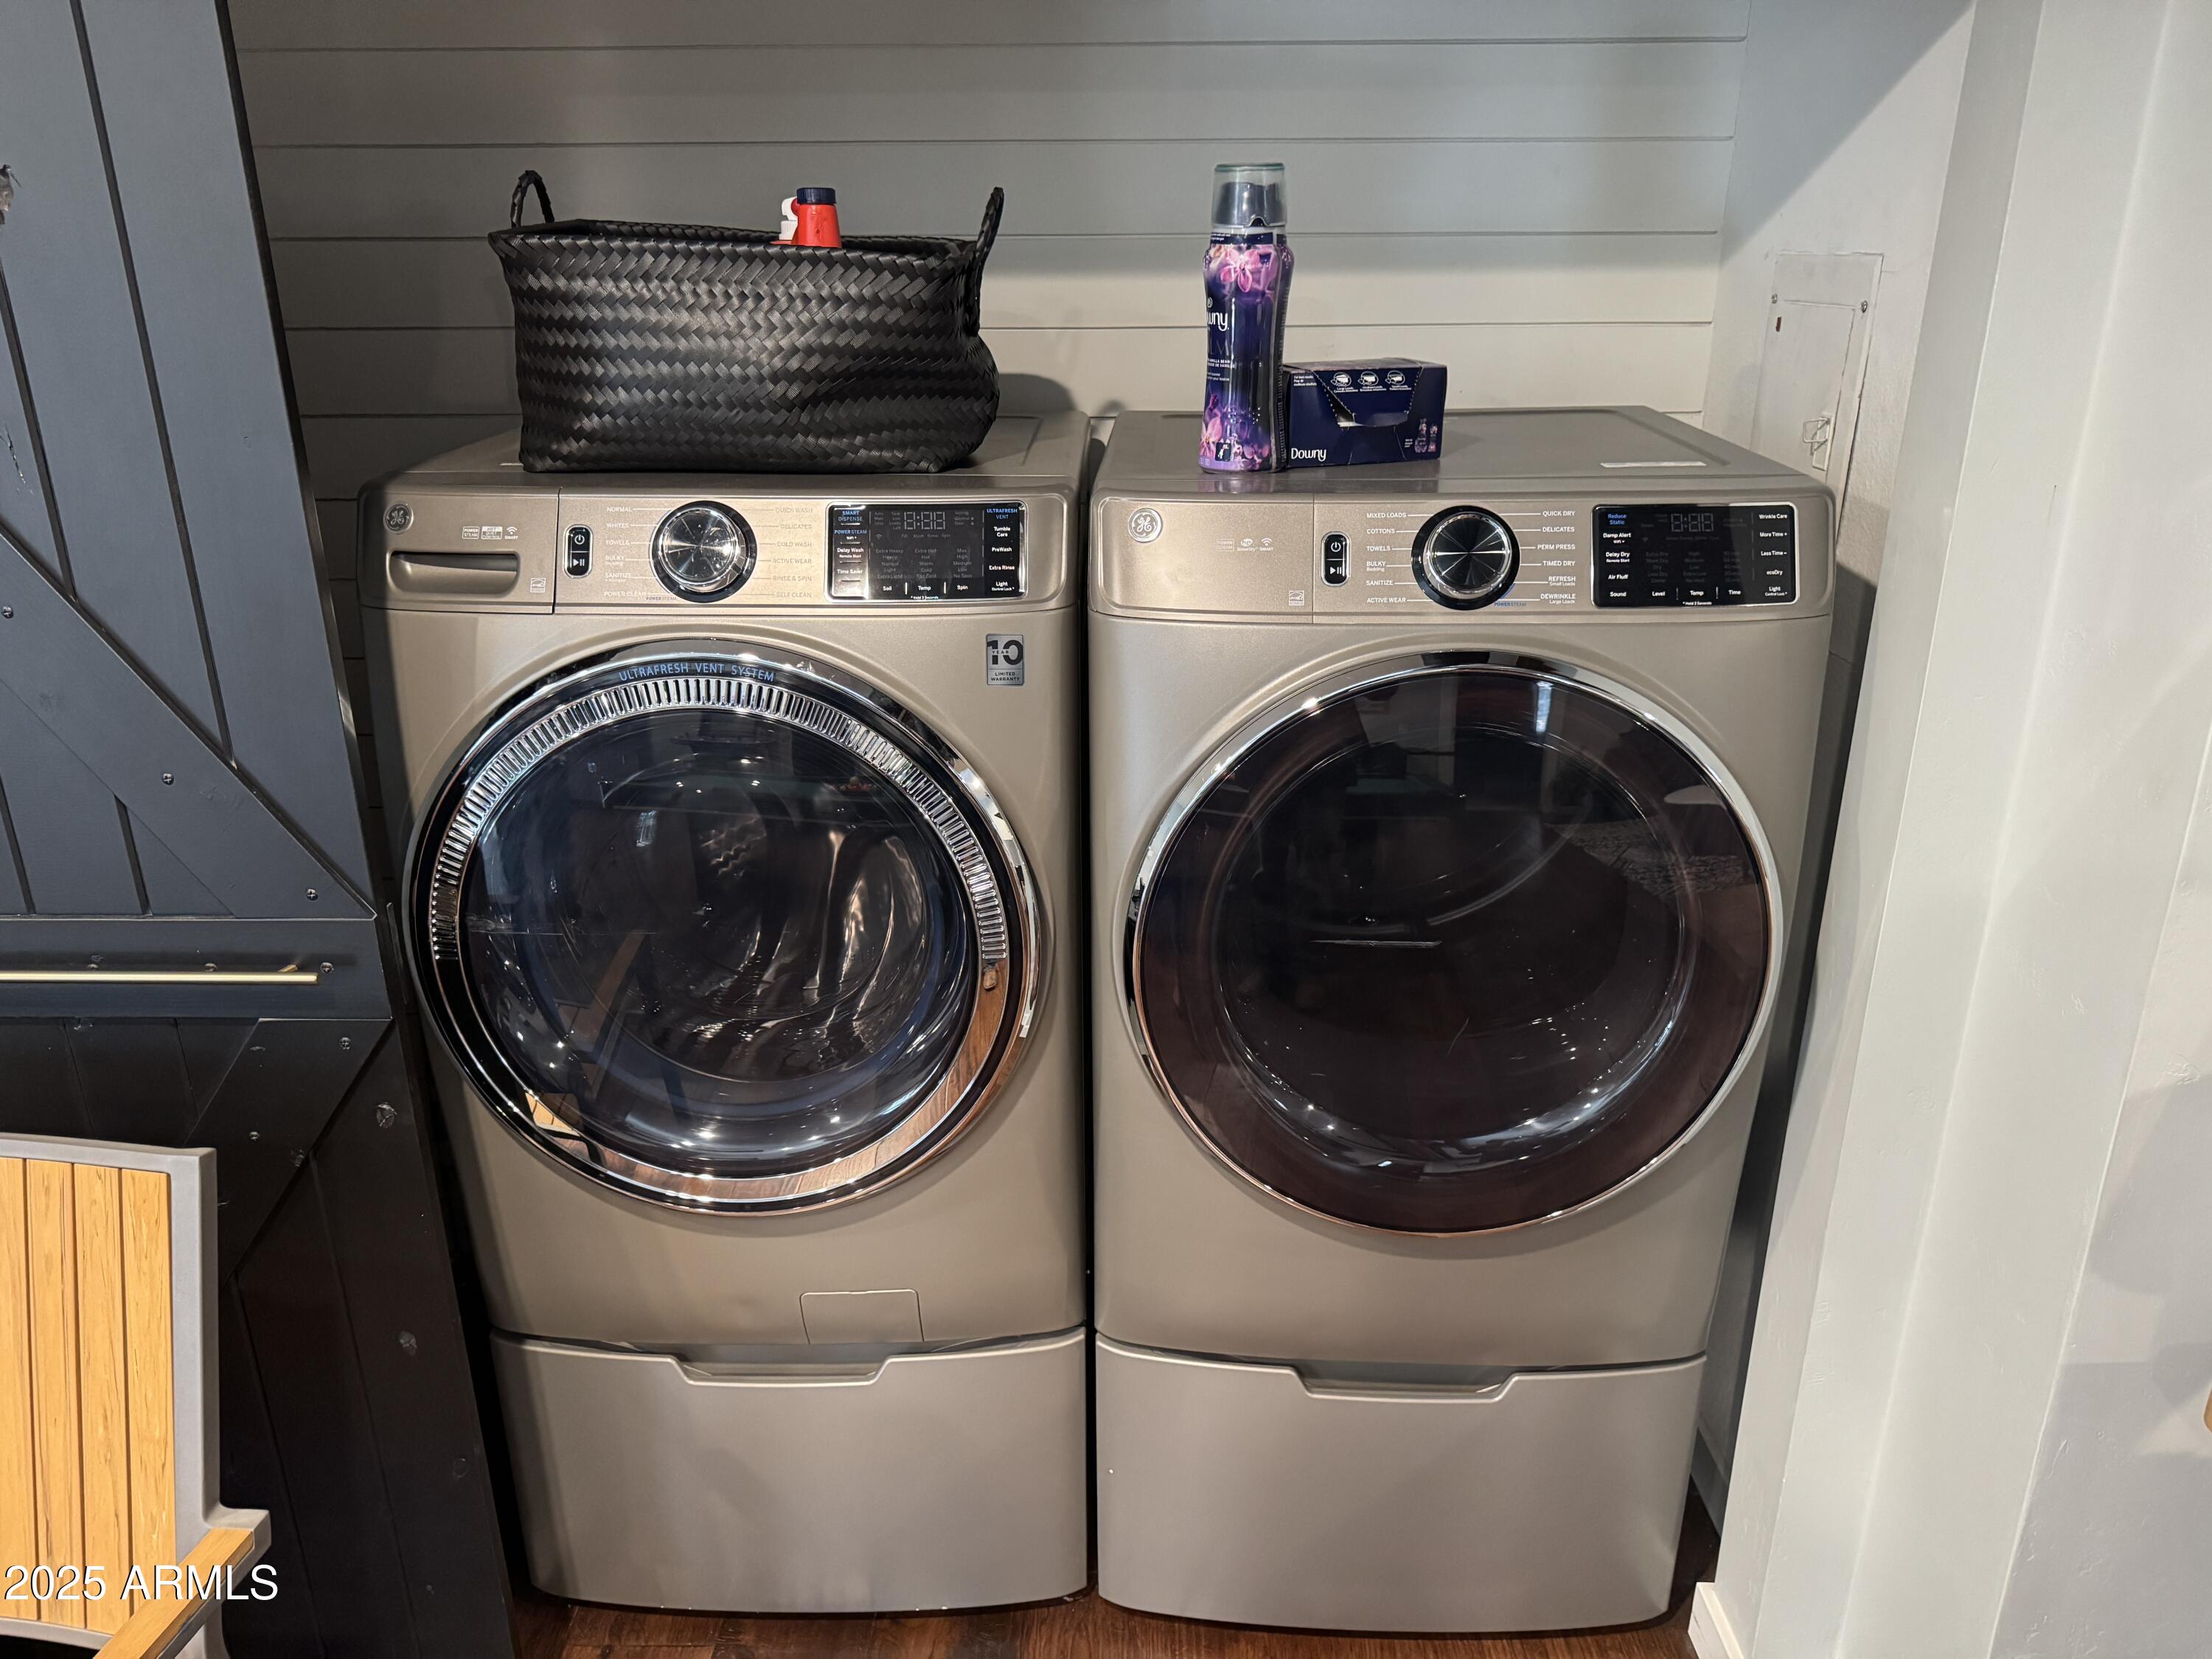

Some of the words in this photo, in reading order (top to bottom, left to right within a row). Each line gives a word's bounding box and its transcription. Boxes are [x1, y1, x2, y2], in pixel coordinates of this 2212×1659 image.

[1291, 448, 1326, 461] Downy
[987, 640, 1023, 665] 10
[619, 663, 689, 681] ULTRAFRESH
[695, 664, 724, 674] VENT
[731, 667, 775, 682] SYSTEM
